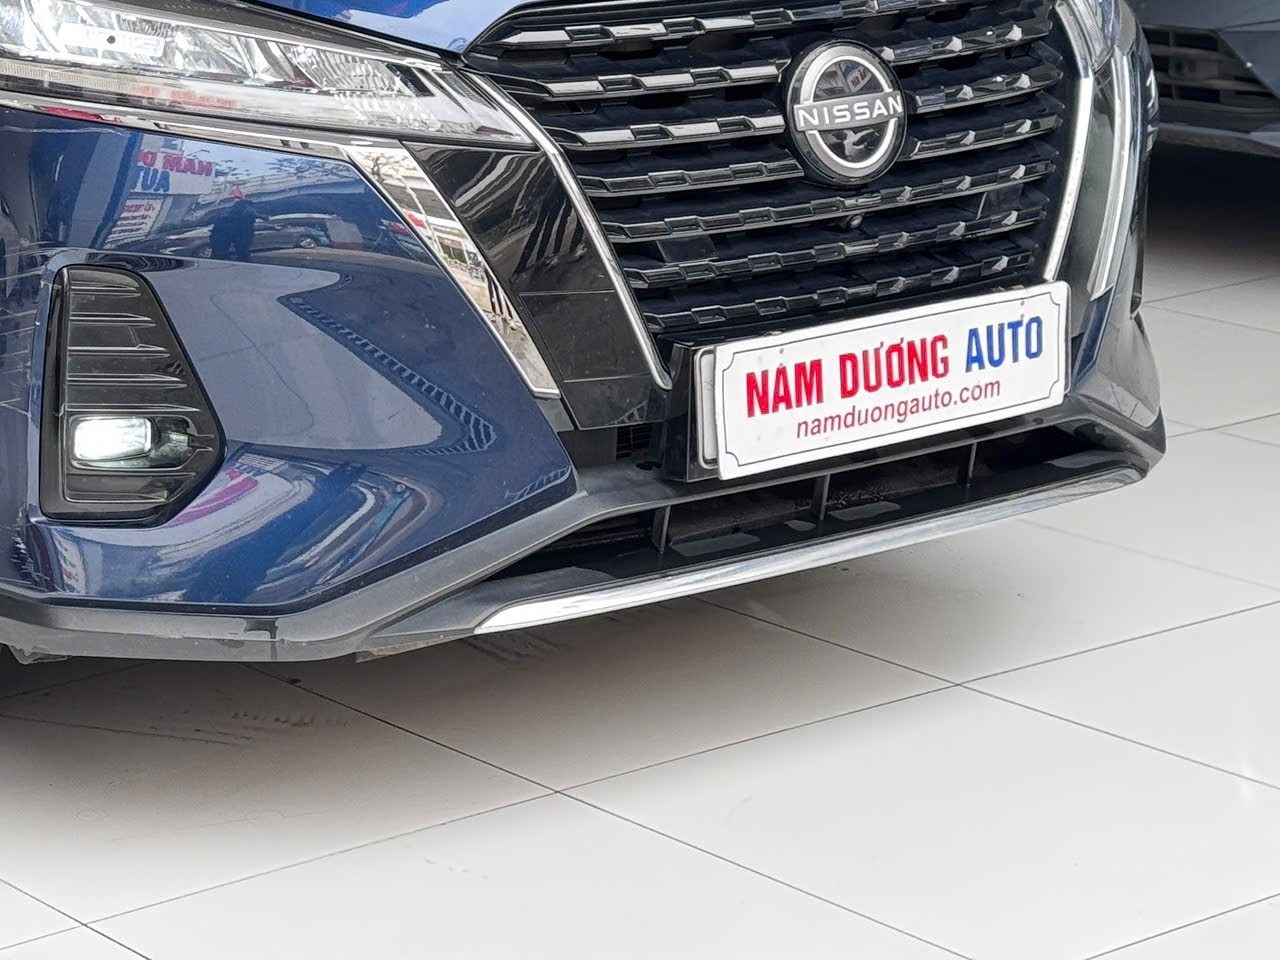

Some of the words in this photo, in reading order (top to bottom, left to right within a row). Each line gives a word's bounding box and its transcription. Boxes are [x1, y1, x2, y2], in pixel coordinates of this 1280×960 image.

[797, 94, 904, 127] NISSAN
[838, 334, 950, 399] DƯƠNG
[965, 315, 1044, 373] AUTO
[796, 378, 1002, 439] namduongauto.com
